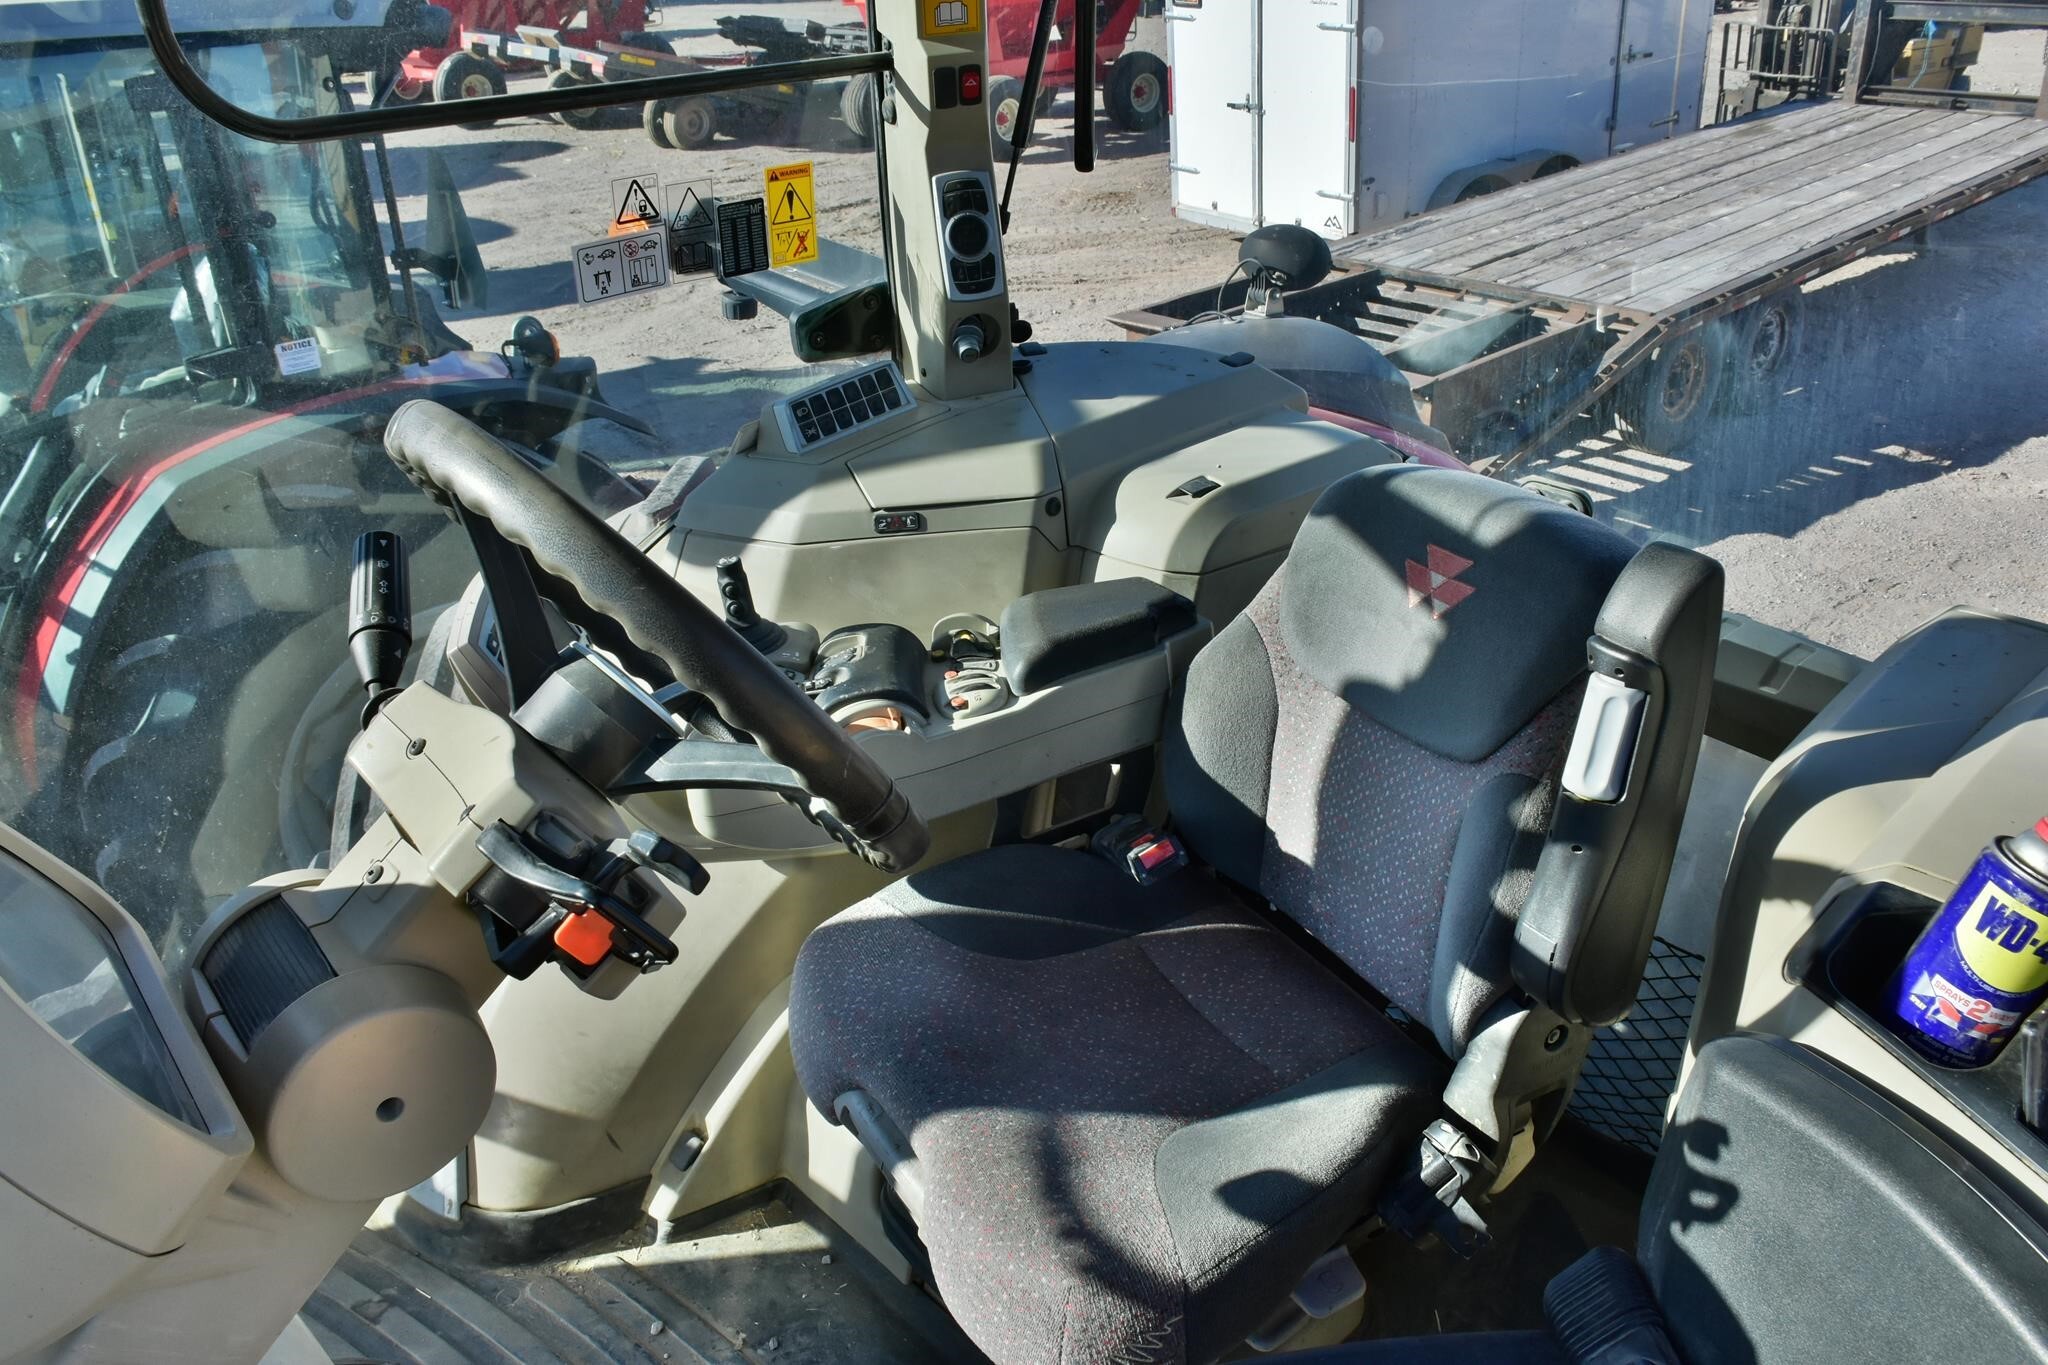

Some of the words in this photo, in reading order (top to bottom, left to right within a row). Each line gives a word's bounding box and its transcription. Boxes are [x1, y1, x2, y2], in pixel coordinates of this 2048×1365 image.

[779, 167, 809, 177] WARNING
[750, 203, 762, 214] MF
[280, 340, 313, 352] NOTICE
[1934, 980, 1971, 1008] SPRAYS
[1966, 999, 1992, 1021] 2
